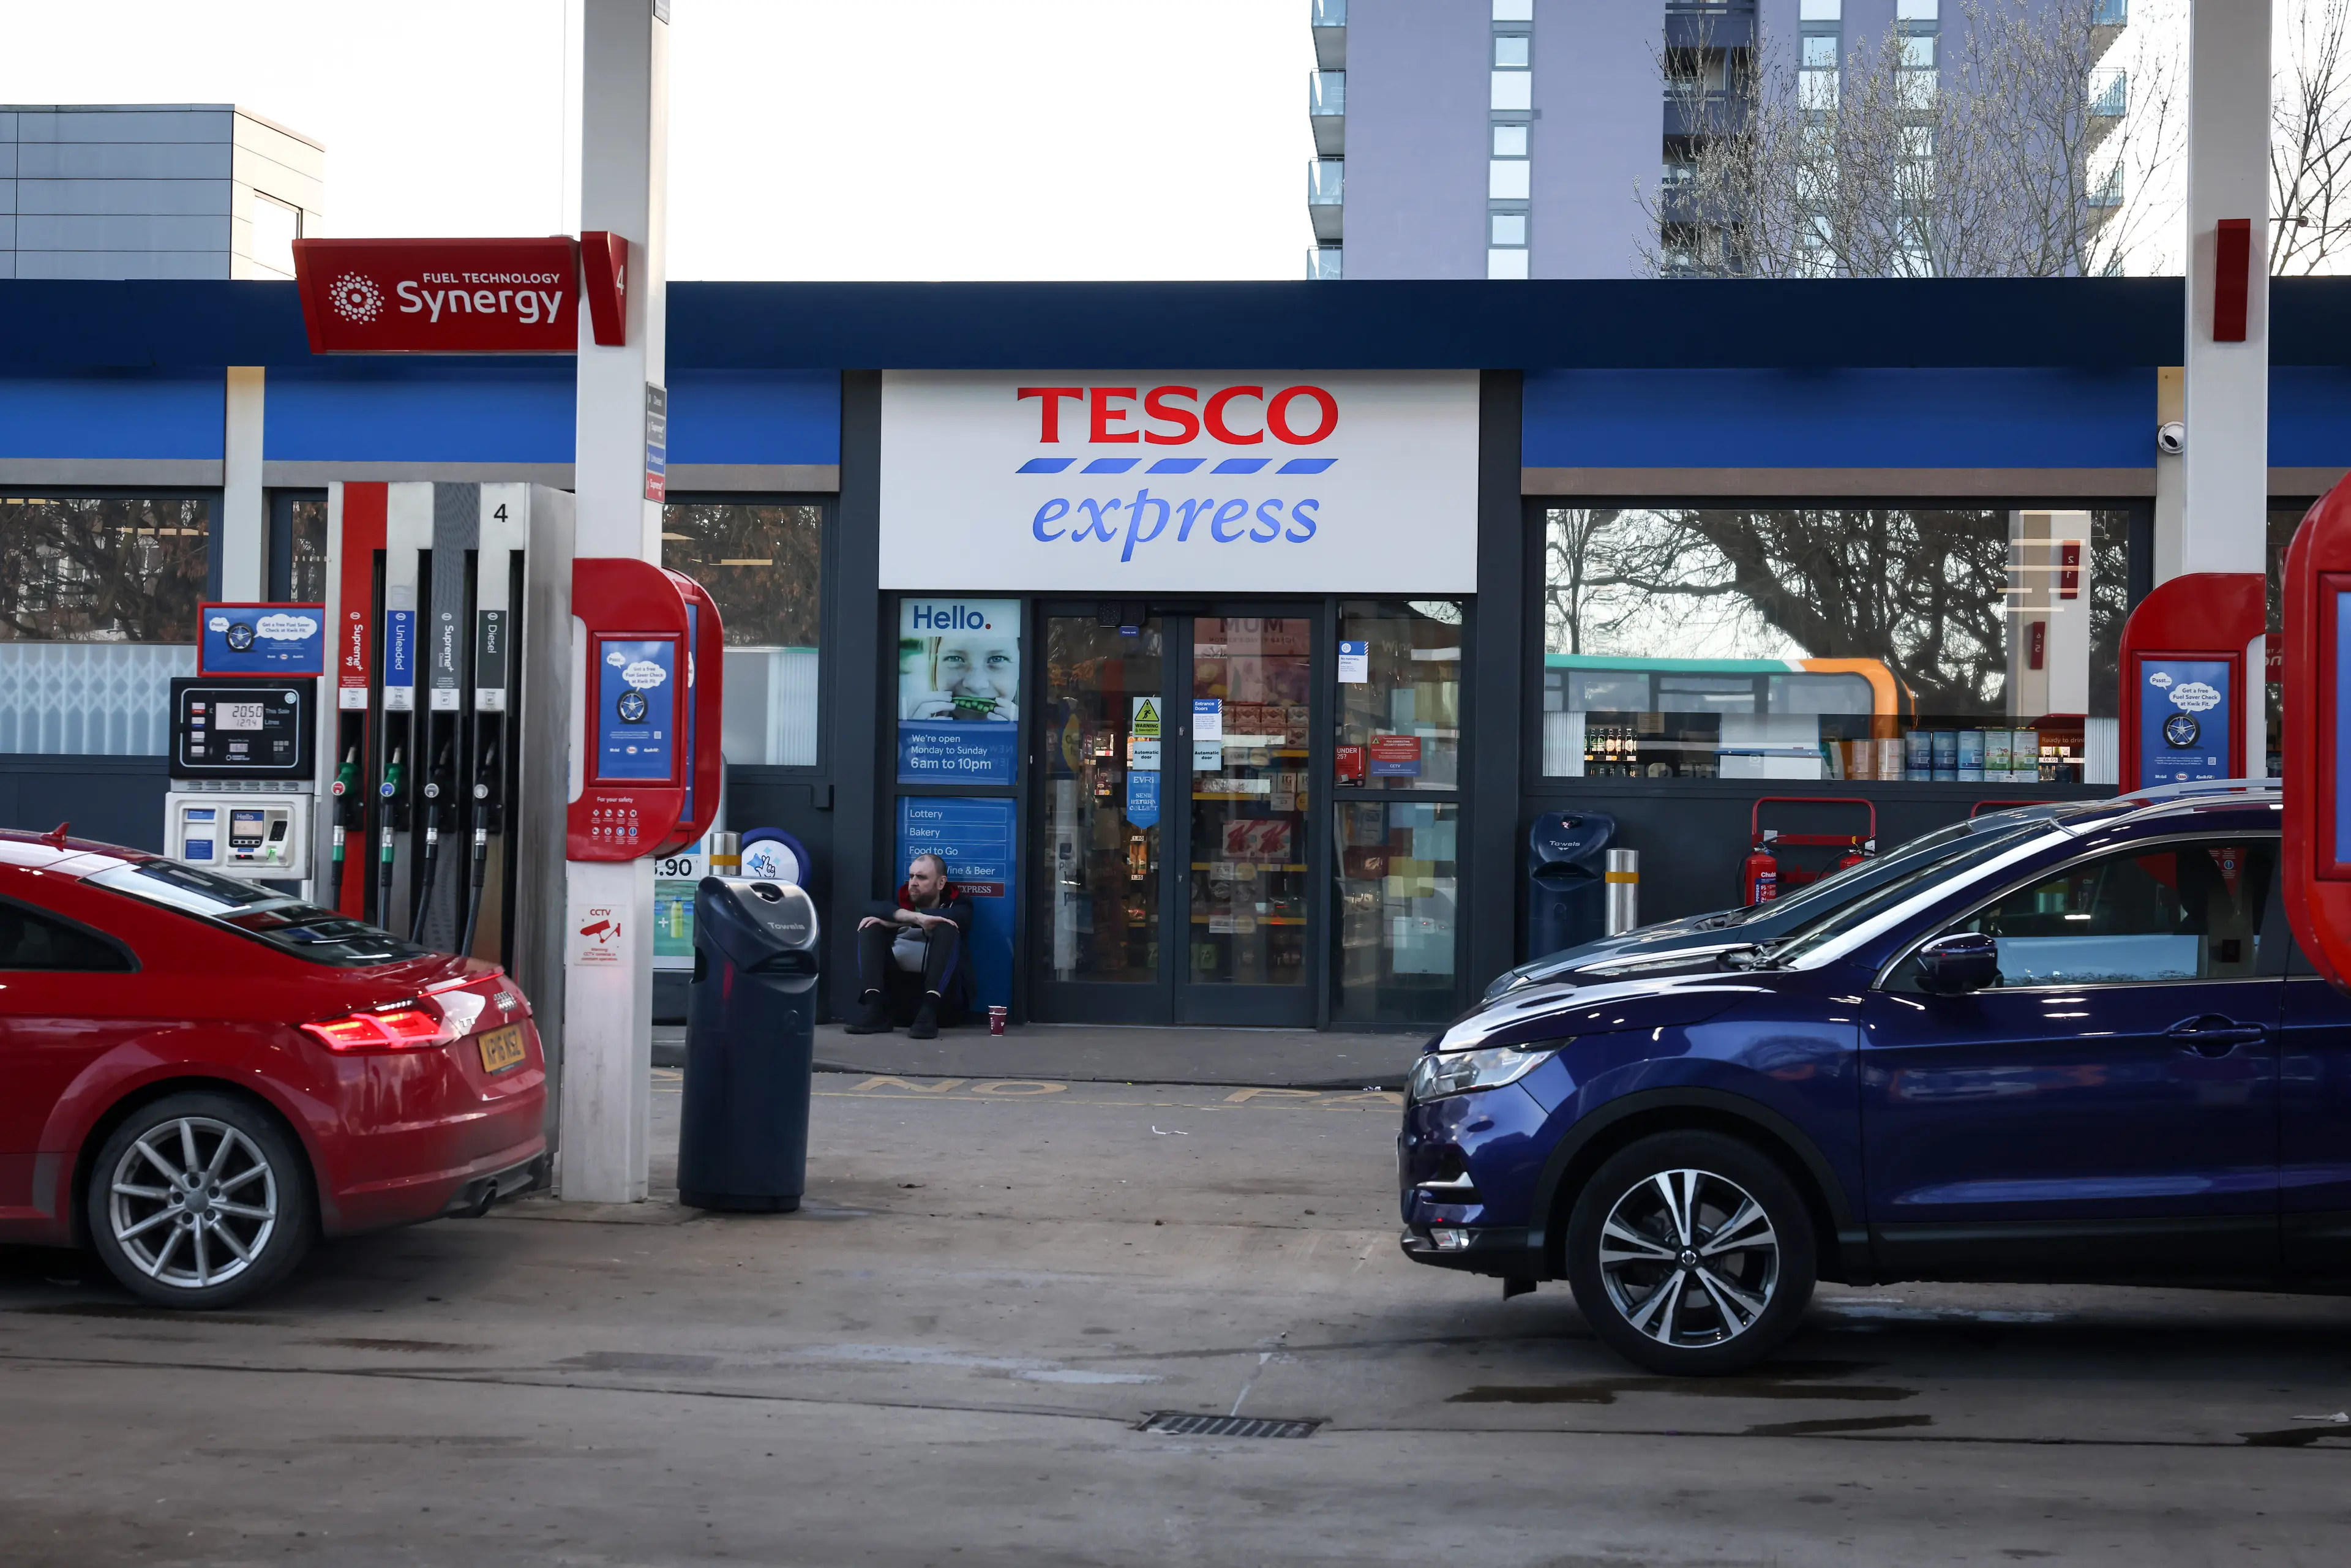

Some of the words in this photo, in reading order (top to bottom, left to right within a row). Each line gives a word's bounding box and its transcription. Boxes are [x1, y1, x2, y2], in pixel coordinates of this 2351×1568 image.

[423, 273, 459, 283] FUEL
[462, 273, 560, 284] TECHNOLOGY
[617, 264, 624, 295] 4
[397, 281, 563, 323] Synergy
[1017, 385, 1339, 445] TESCO
[493, 503, 508, 522] 4
[1032, 488, 1320, 563] express
[913, 605, 991, 629] Hello.
[487, 625, 497, 653] Diesel
[1382, 640, 1414, 653] Wine
[351, 624, 364, 672] Supreme+
[395, 625, 405, 670] Unleaded
[443, 625, 454, 672] Supreme+
[345, 656, 353, 666] 99
[912, 734, 937, 743] We're
[938, 735, 961, 744] open
[911, 746, 944, 756] Monday
[957, 746, 988, 756] Sunday
[910, 757, 939, 769] 6am
[942, 757, 955, 769] to
[958, 758, 992, 772] 10pm
[910, 809, 943, 820] Lottery
[909, 828, 940, 839] Bakery
[909, 846, 932, 855] Food
[945, 847, 958, 855] Go
[654, 858, 692, 876] .90
[974, 866, 996, 875] Beer
[459, 1016, 476, 1027] TT
